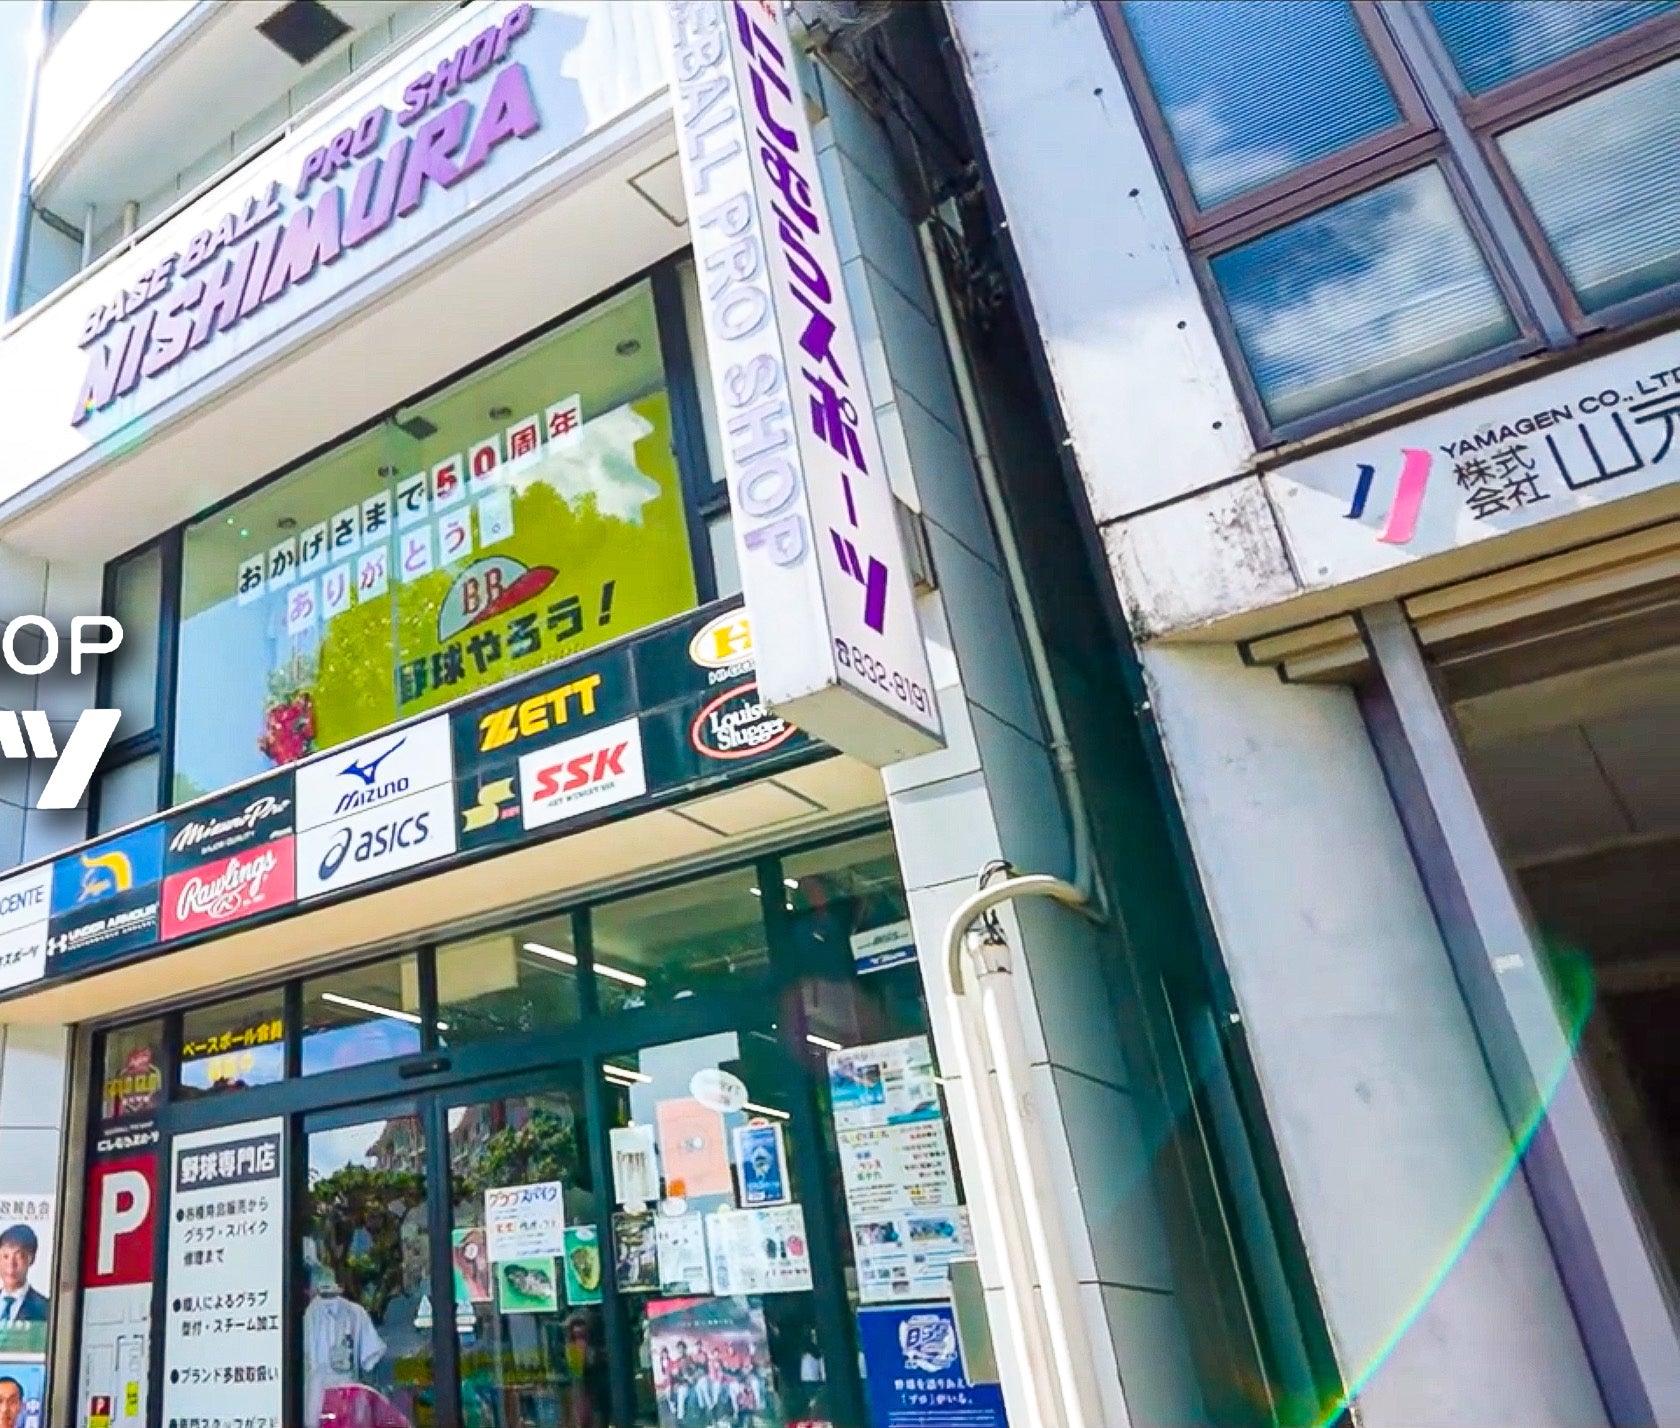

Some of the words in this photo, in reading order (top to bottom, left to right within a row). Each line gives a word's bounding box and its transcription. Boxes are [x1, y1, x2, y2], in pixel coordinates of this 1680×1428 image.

[78, 251, 179, 349] BASE
[178, 180, 282, 279] BALL
[296, 105, 387, 199] PRO
[397, 7, 534, 128] SHOP
[71, 62, 543, 427] NISHIMURA
[699, 191, 769, 341] PRO
[733, 1, 888, 635] にしむらスポーツ
[722, 353, 808, 568] SHOP
[1440, 404, 1573, 459] YAMAGEN
[241, 406, 578, 590] おかげさまで50周年
[479, 674, 602, 752] ZETT
[717, 717, 785, 750] Slugger
[533, 741, 629, 801] SSK
[176, 849, 277, 922] Rawlings
[181, 1142, 276, 1184] 野球専門店
[97, 1169, 151, 1277] P
